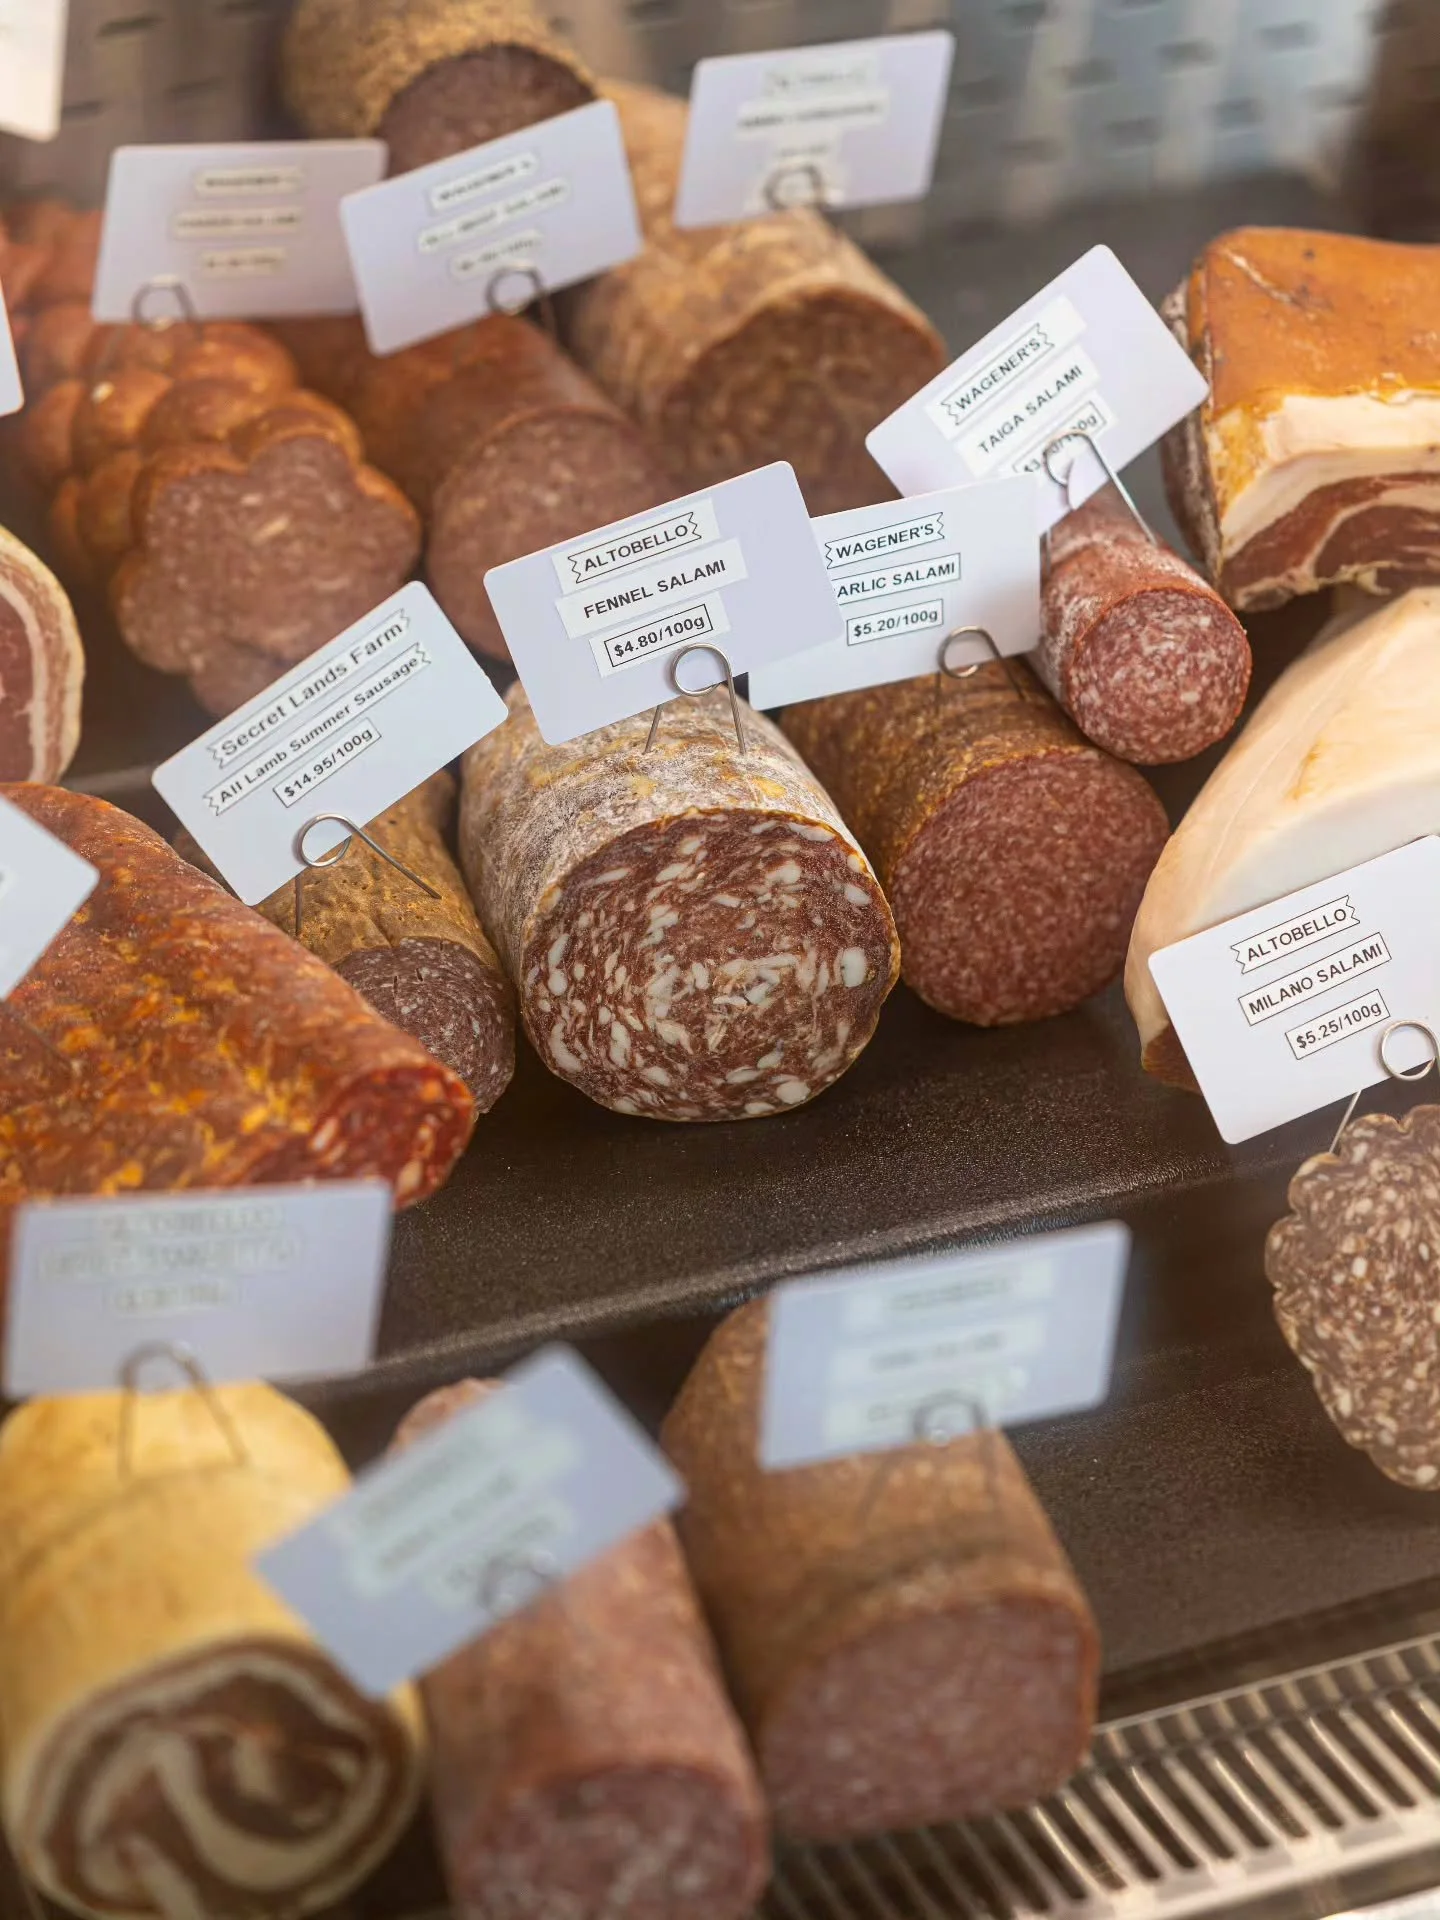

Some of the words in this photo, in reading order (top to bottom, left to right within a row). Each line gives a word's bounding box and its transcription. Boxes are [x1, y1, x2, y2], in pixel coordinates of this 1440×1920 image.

[955, 338, 1041, 410] WAGENER'S
[978, 414, 1025, 453] TAIGA
[1025, 365, 1083, 416] SALAMI
[584, 524, 688, 572] ALTOBELLO
[836, 523, 934, 559] WAGENER'S
[583, 586, 654, 619] FENNEL
[657, 559, 726, 593] SALAMI
[834, 577, 887, 598] ARLIC
[892, 562, 955, 586] SALAMI
[614, 616, 705, 657] $4.80/100g
[854, 610, 938, 637] $5.20/100g
[220, 705, 287, 757] Secret
[289, 665, 348, 708] Lands
[349, 622, 404, 665] Farm
[219, 781, 244, 803] All
[244, 750, 288, 785] Lamb
[289, 705, 352, 752] Summer
[353, 656, 419, 707] Sausage
[284, 728, 374, 798] $14.95/100g
[1248, 908, 1347, 962] ALTOBELLO
[1249, 977, 1314, 1016] MILANO
[1316, 943, 1383, 983] SALAMI
[1296, 1002, 1382, 1049] $5.25/100g
